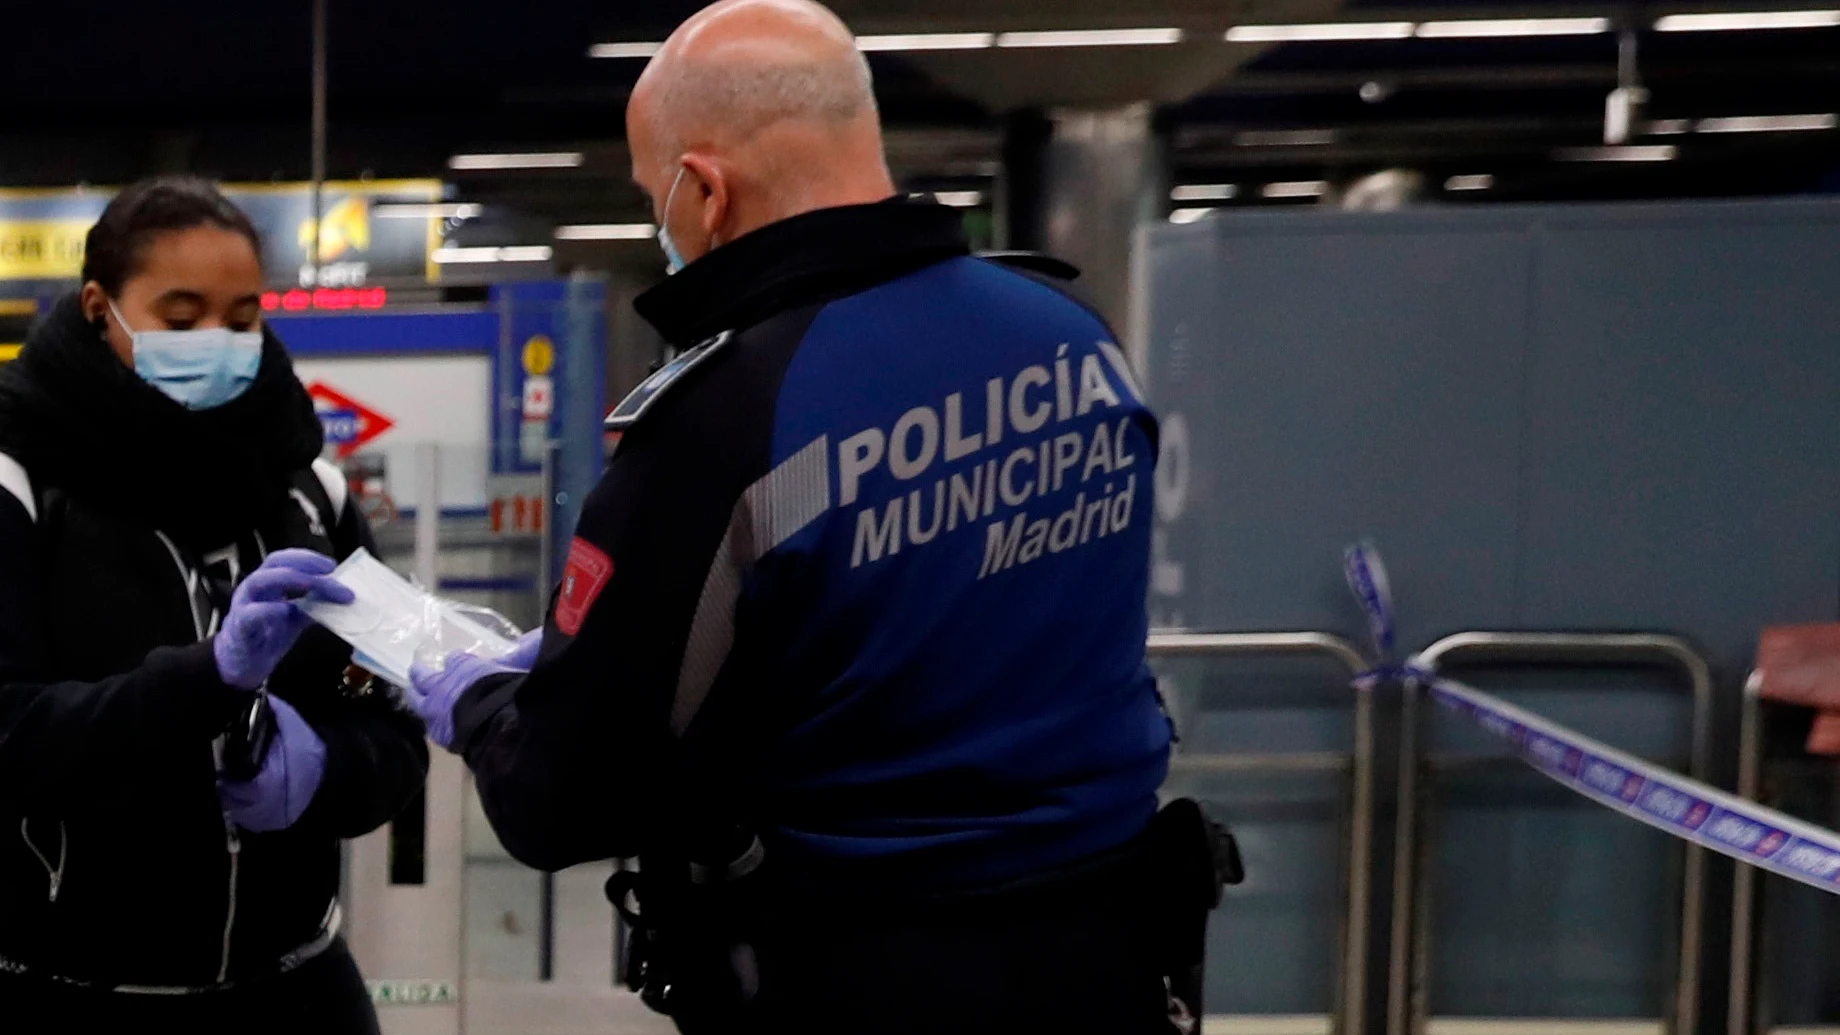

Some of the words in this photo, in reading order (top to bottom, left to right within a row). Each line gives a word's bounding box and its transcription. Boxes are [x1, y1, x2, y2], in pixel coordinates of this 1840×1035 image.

[838, 343, 1120, 507] POLICÍA
[850, 415, 1136, 569] MUNICIPAL
[976, 474, 1137, 581] Madrid
[366, 983, 451, 1004] ALIDA
